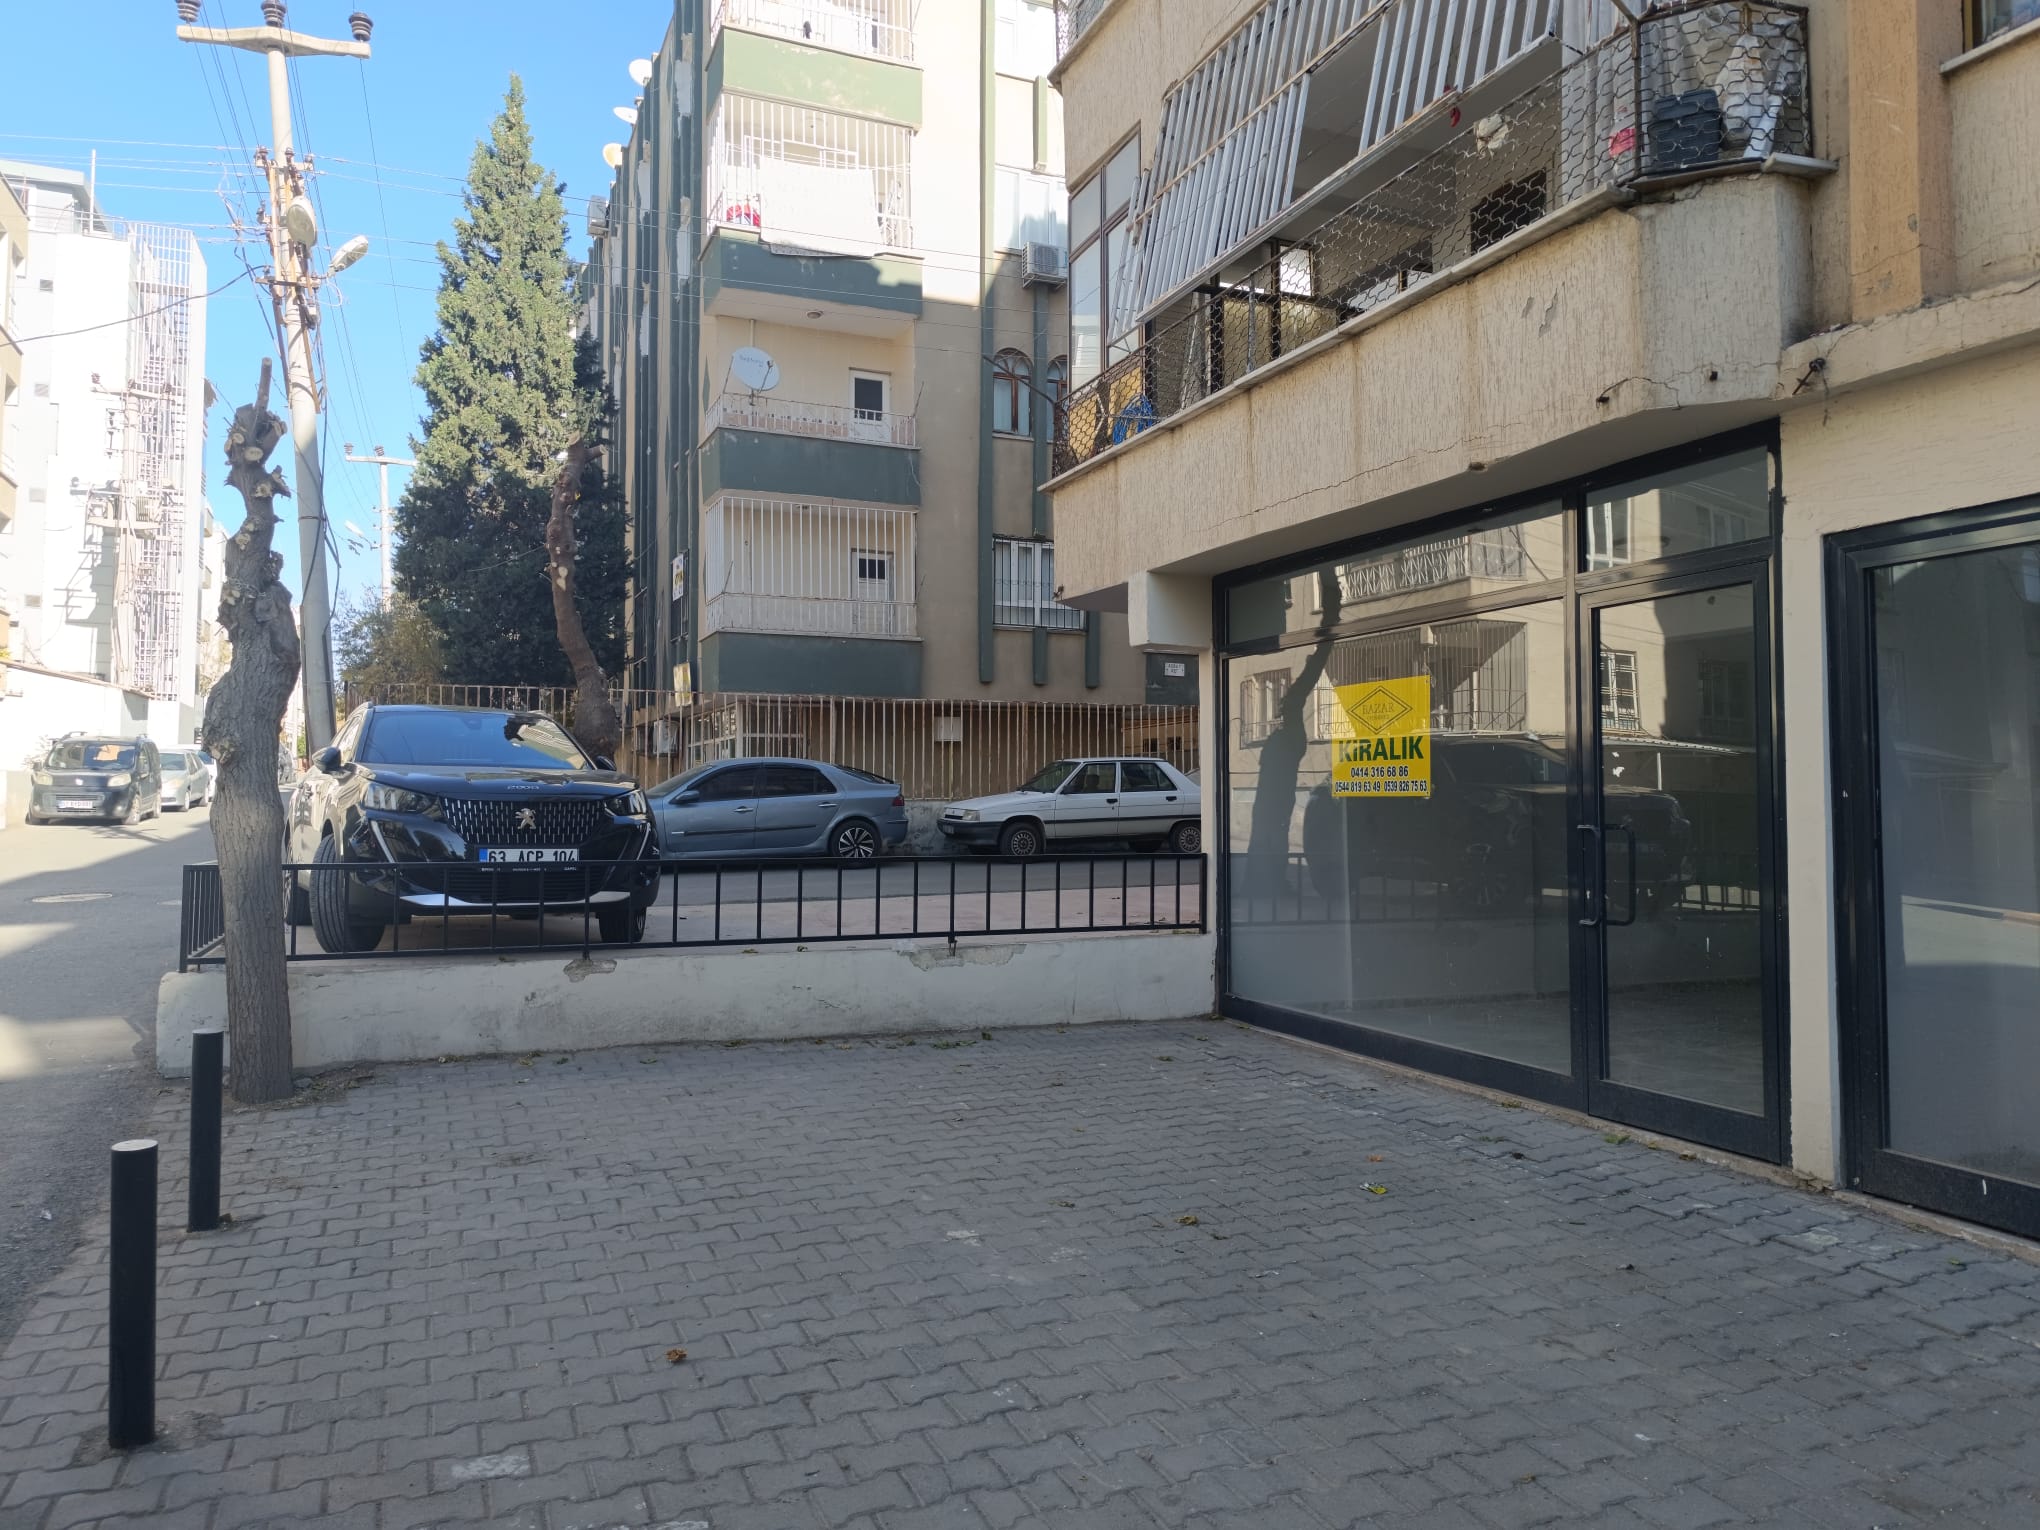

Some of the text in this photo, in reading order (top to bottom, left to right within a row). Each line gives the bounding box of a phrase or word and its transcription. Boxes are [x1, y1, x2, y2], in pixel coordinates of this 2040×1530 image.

[1351, 766, 1409, 778] 0414 316 68 86
[1373, 781, 1381, 792] 49
[1411, 780, 1419, 792] 75
[489, 850, 506, 862] 63
